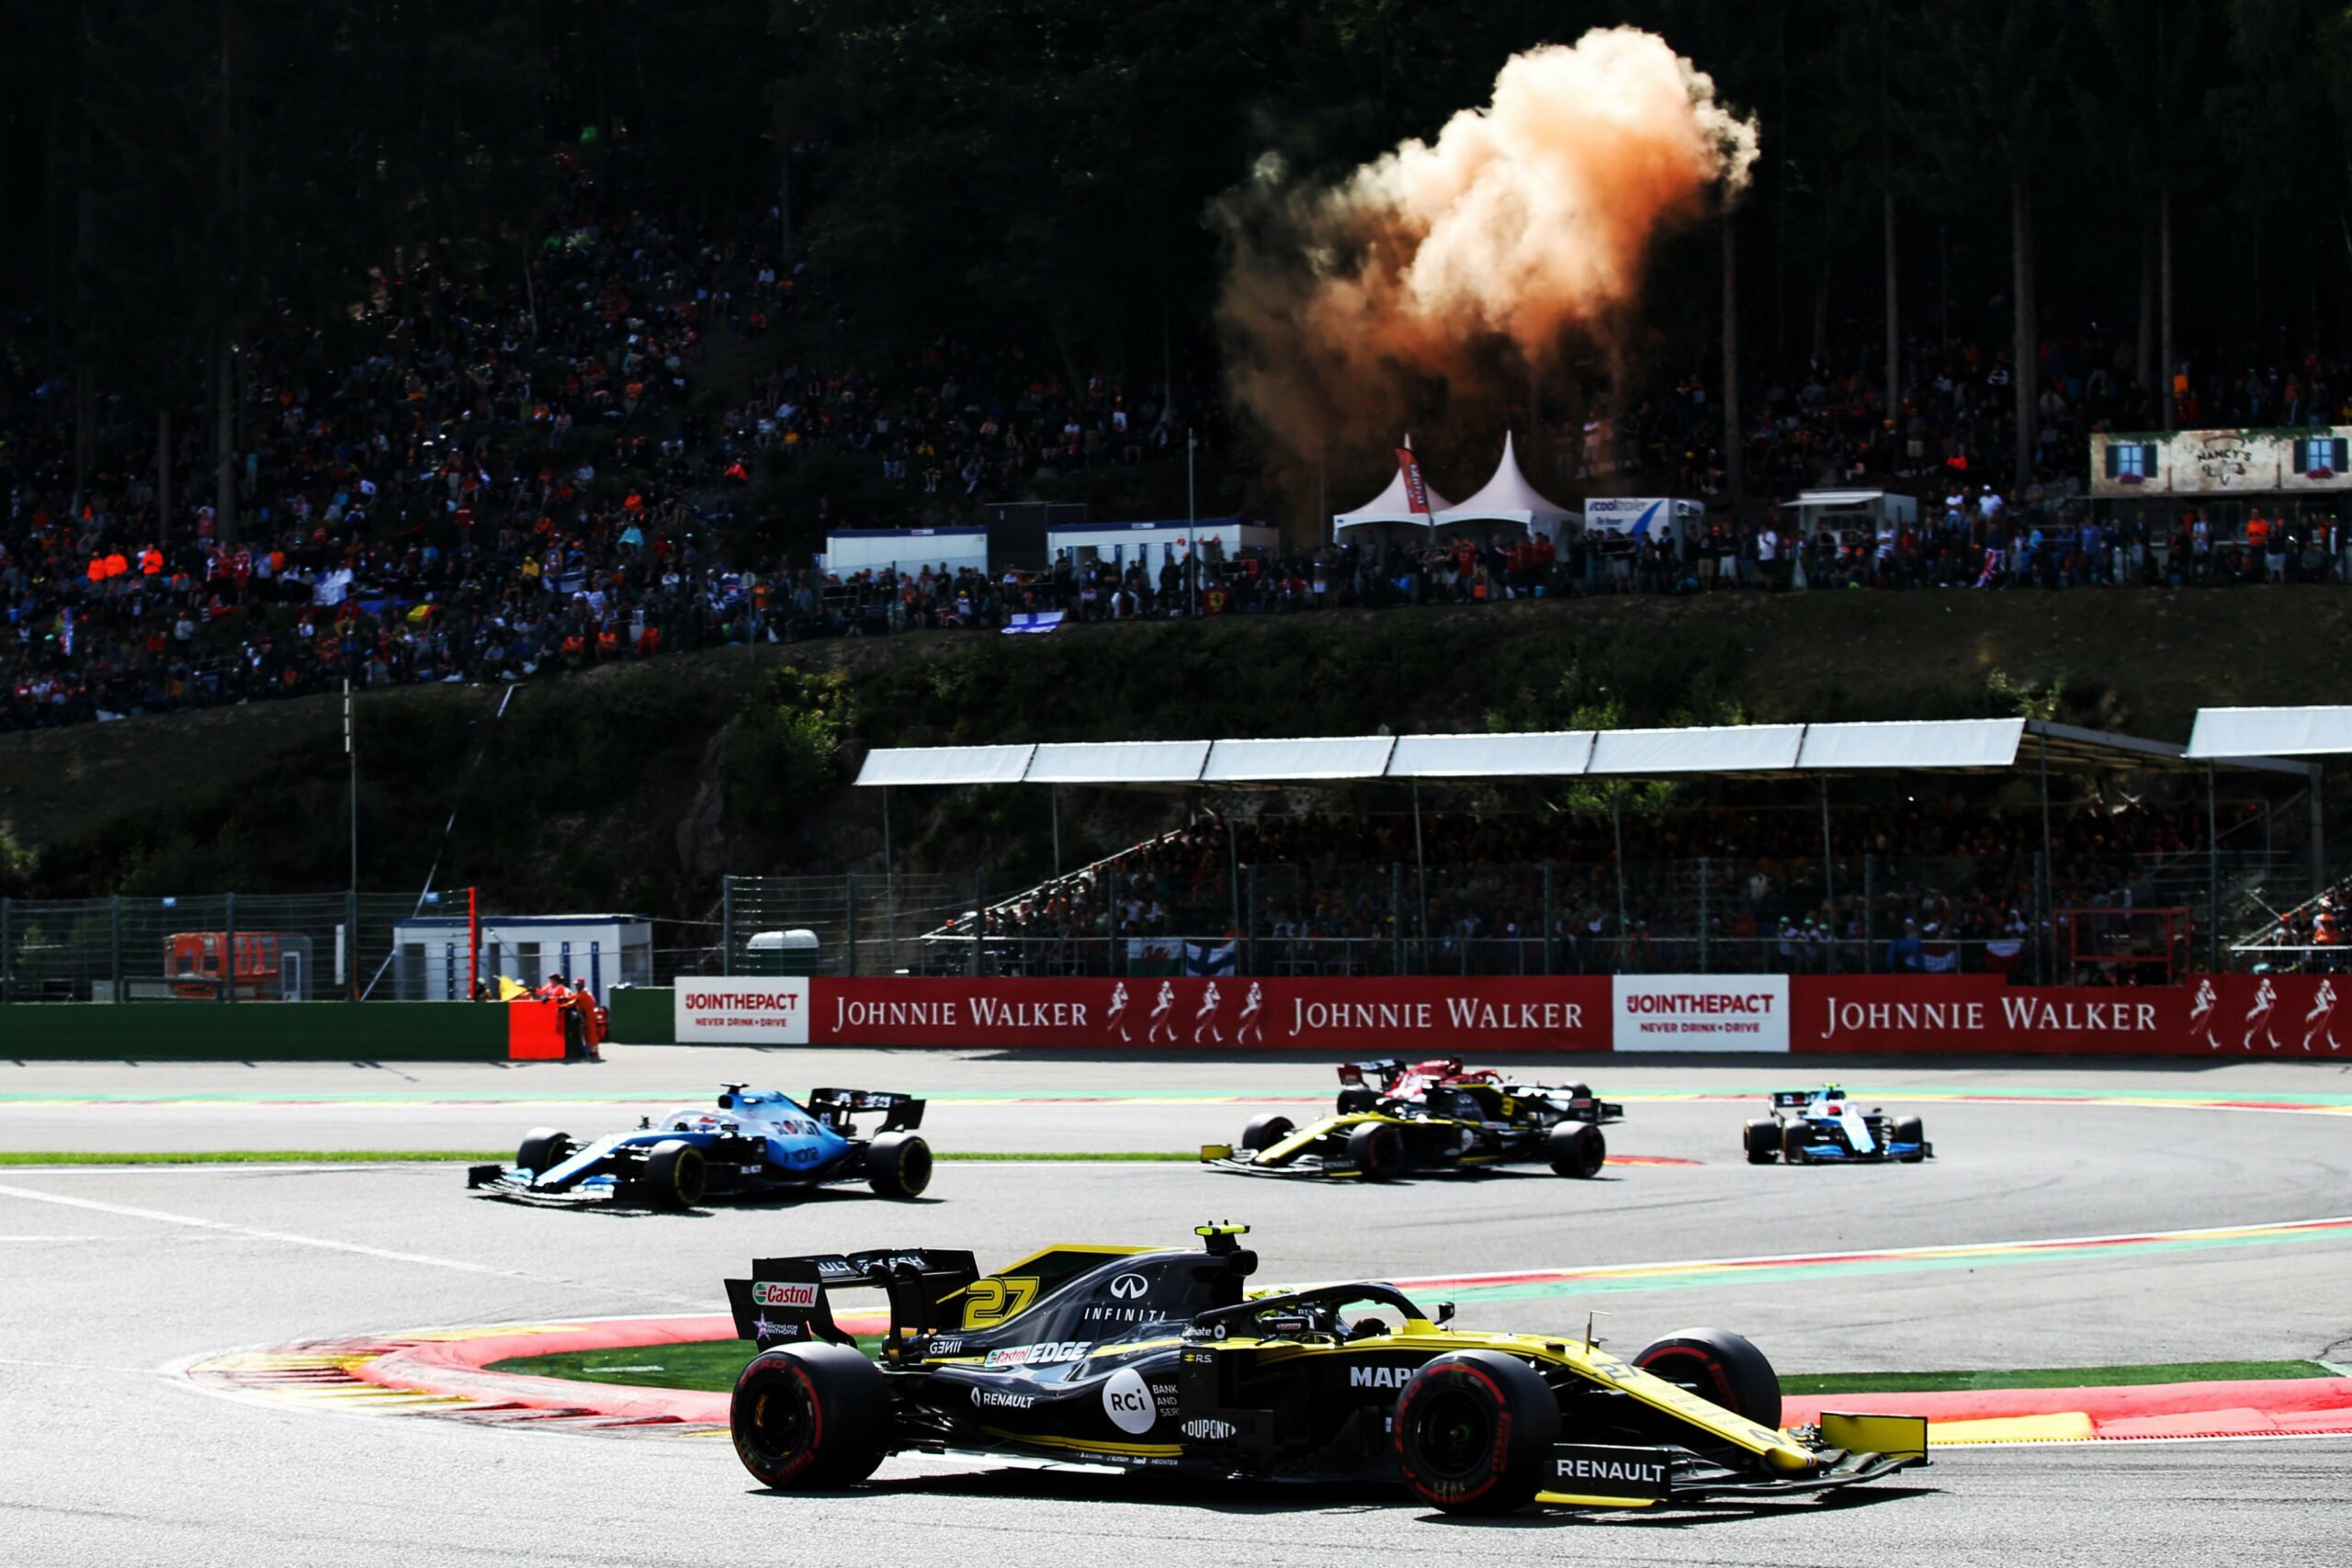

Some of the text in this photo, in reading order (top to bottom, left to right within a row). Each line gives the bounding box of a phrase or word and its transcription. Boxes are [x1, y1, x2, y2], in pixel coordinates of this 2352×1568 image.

[2197, 449, 2252, 462] NANCY'S
[695, 1018, 725, 1027] NEVER
[832, 996, 1087, 1032] JOHNNIE WALKER
[1289, 997, 1583, 1036] JOHNNIE WALKER
[1821, 997, 2156, 1039] JOHNNIE WALKER
[1640, 1022, 1679, 1032] NEVER
[818, 1260, 851, 1272] AULT
[767, 1285, 814, 1303] Castrol
[961, 1276, 1040, 1331] 27
[1084, 1307, 1166, 1322] INFINITI
[1025, 1342, 1092, 1364] EDGE
[1350, 1366, 1419, 1388] MAP
[1152, 1384, 1178, 1394] BANK
[983, 1393, 1035, 1408] RENAULT
[1111, 1389, 1146, 1411] RCi
[1157, 1397, 1177, 1406] AND
[1160, 1408, 1181, 1417] SER
[1187, 1419, 1230, 1438] DUPONT
[1556, 1459, 1667, 1483] RENAULT
